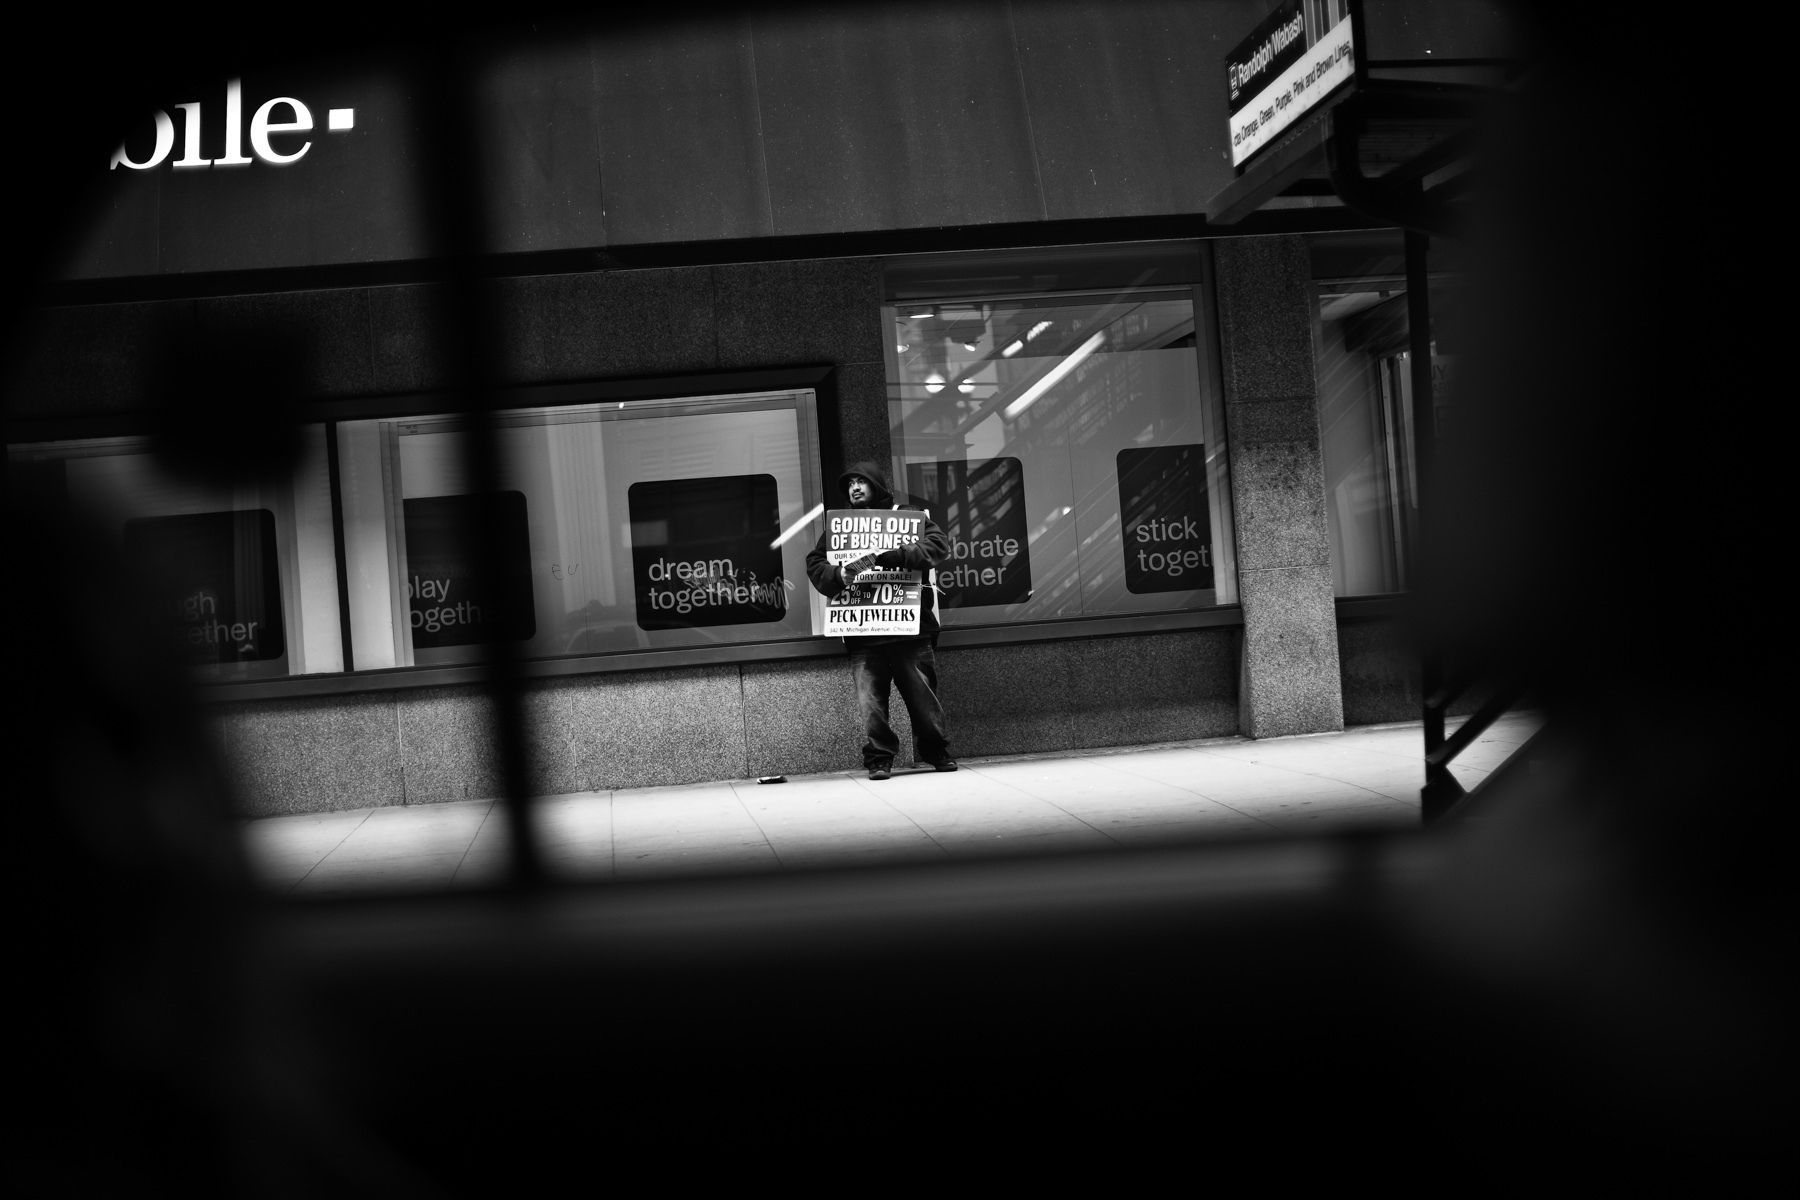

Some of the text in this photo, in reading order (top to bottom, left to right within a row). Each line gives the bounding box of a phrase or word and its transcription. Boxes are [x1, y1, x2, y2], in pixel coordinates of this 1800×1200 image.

[1238, 10, 1304, 87] Randolph/Wabash
[1293, 78, 1305, 98] Pink
[1305, 65, 1316, 88] and
[1316, 54, 1334, 79] Brown
[831, 517, 921, 534] GOING OUT
[1136, 515, 1199, 543] stick
[831, 534, 848, 550] OF
[648, 557, 734, 582] dream
[1137, 543, 1214, 577] toget
[856, 573, 875, 581] TORY
[877, 573, 887, 581] ON
[649, 583, 760, 614] together
[830, 608, 916, 627] PECK JEWELERS
